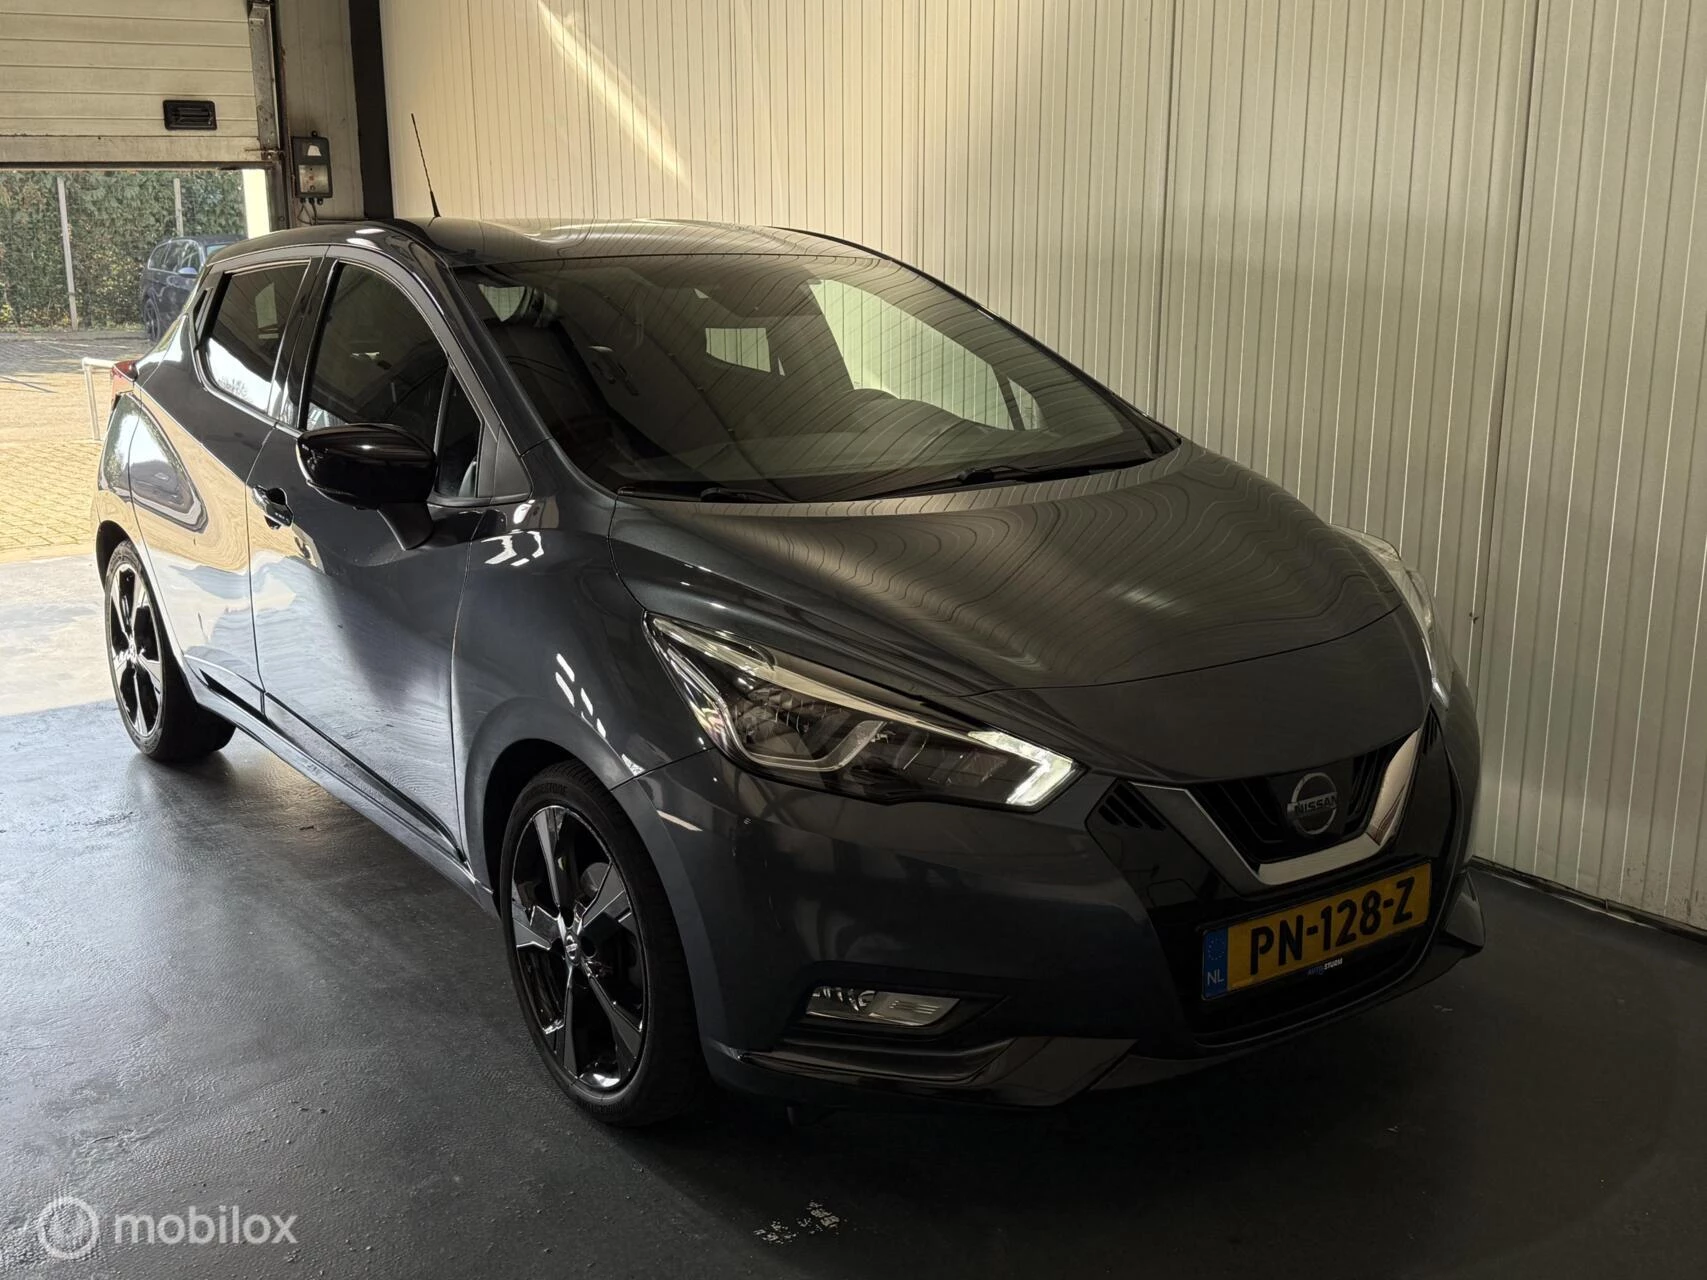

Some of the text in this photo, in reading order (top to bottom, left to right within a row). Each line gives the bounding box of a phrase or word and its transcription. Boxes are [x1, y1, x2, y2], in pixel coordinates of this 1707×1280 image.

[1294, 793, 1334, 812] NISSAN
[1250, 876, 1416, 976] PN-128-Z
[1207, 968, 1225, 986] NL
